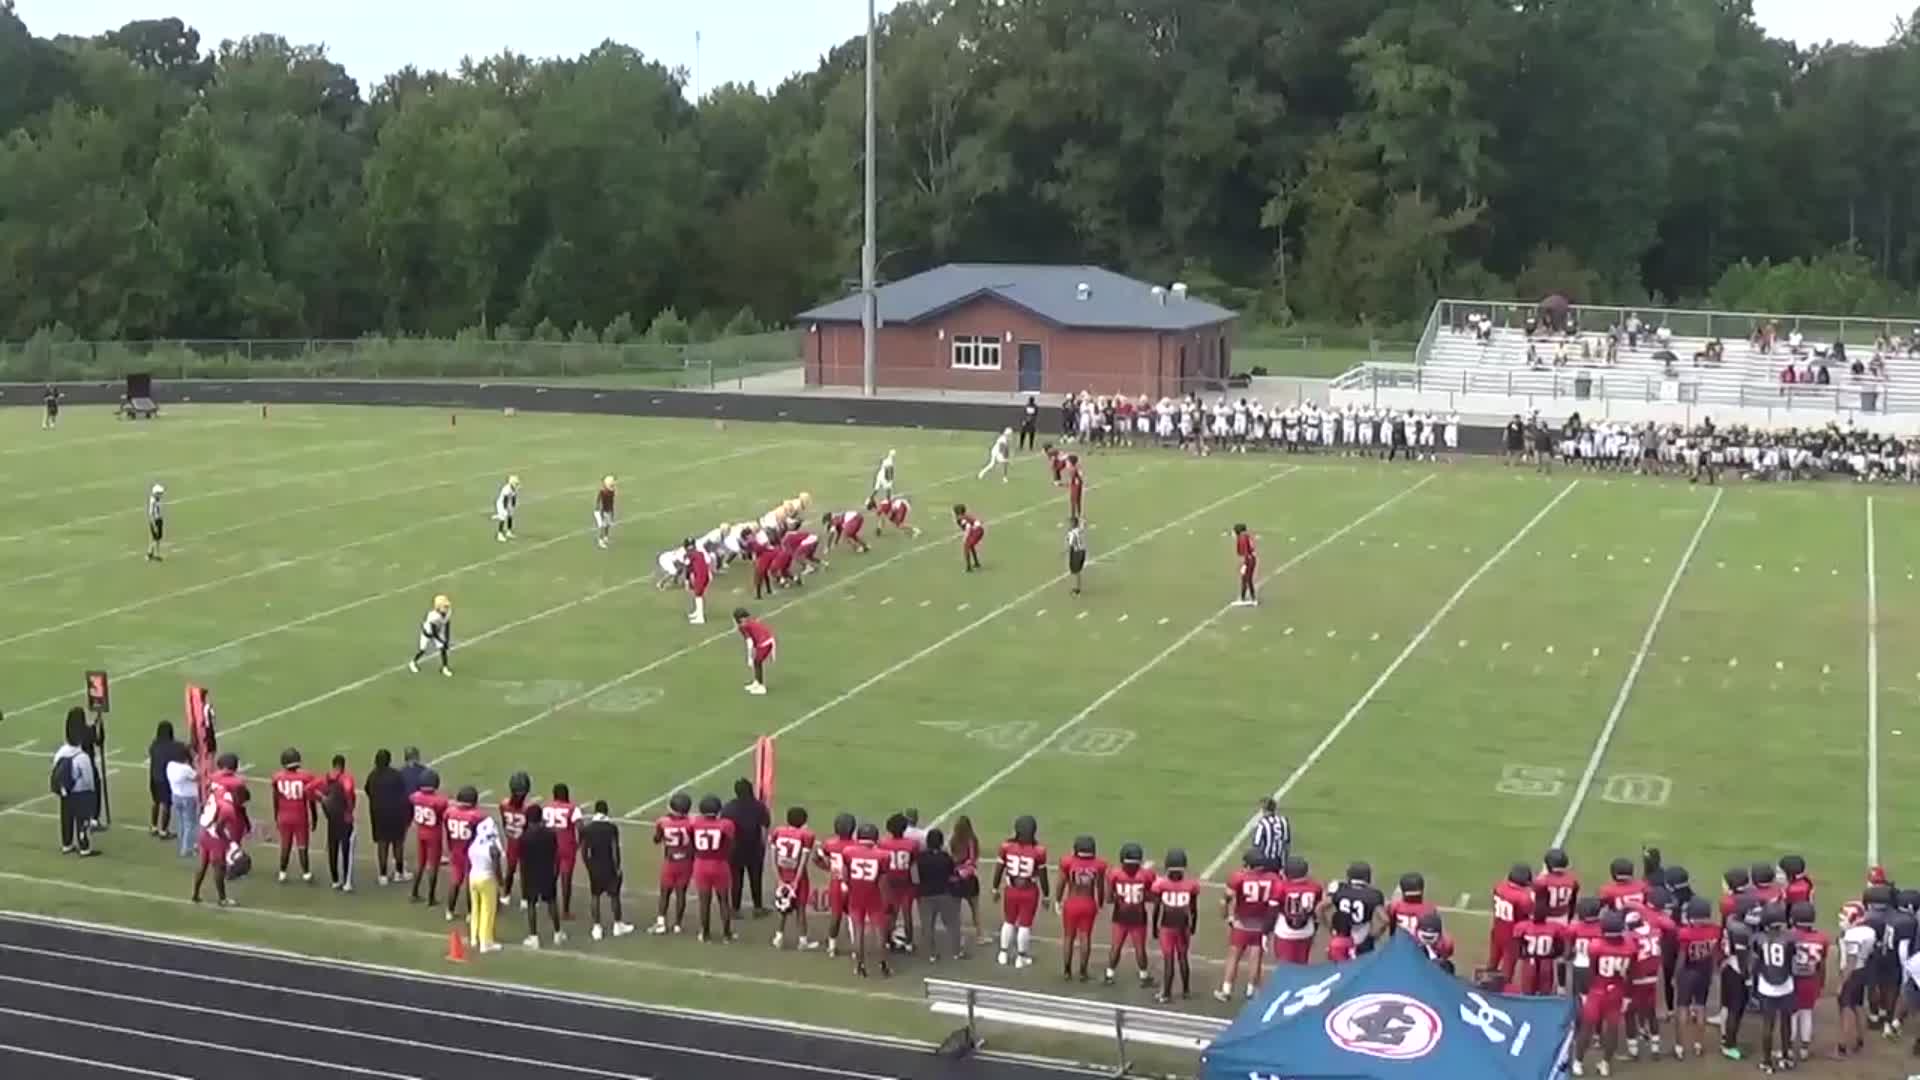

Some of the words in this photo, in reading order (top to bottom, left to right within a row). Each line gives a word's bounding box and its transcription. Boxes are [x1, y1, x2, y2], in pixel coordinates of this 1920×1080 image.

[542, 807, 569, 828] 95
[447, 819, 472, 840] 96
[694, 828, 722, 850] 67
[850, 857, 879, 881] 53
[1006, 854, 1035, 877] 33
[1243, 880, 1272, 903] 97
[1524, 935, 1553, 957] 70
[1763, 942, 1785, 967] 18
